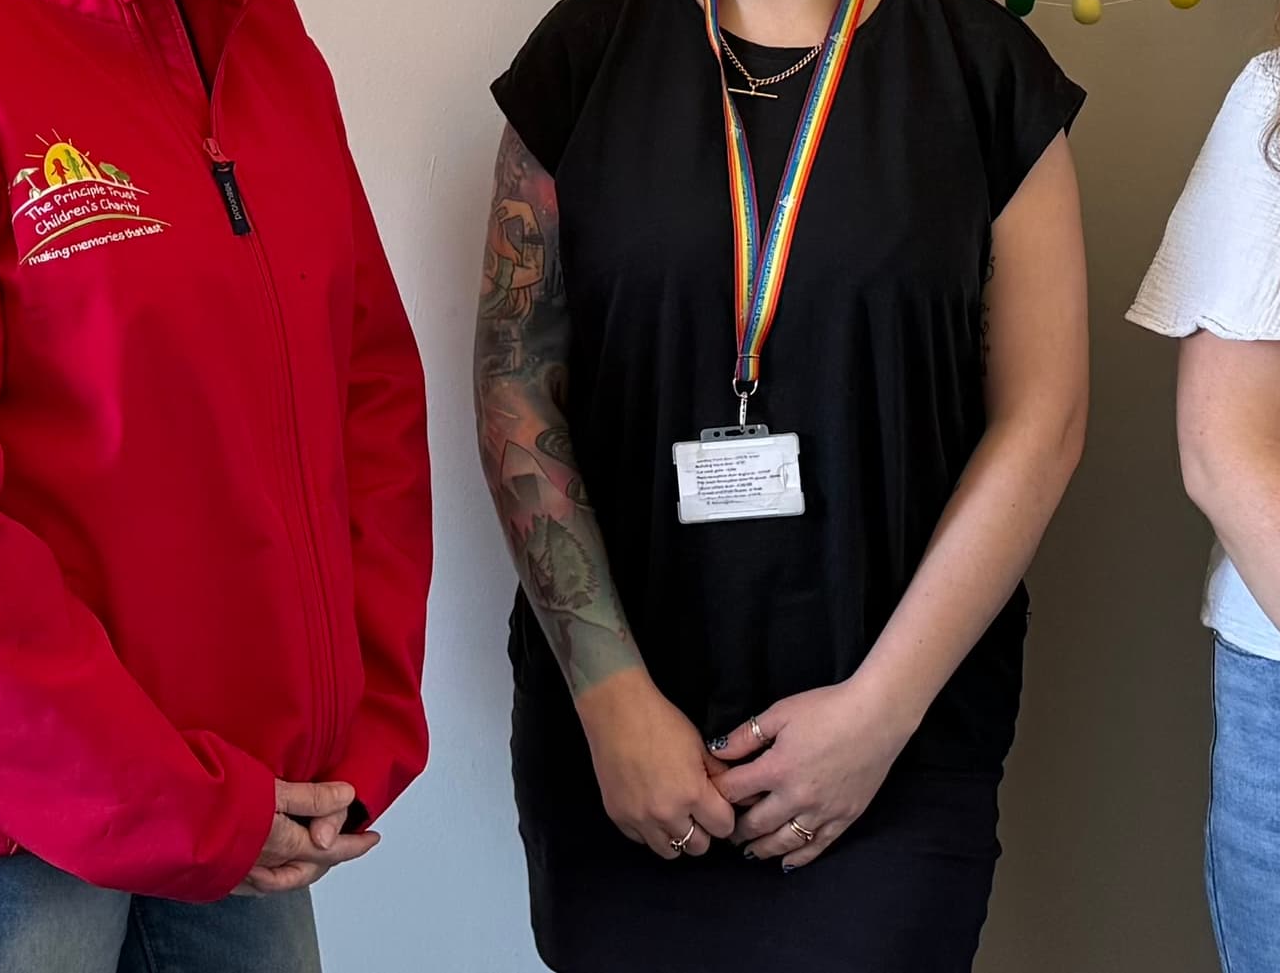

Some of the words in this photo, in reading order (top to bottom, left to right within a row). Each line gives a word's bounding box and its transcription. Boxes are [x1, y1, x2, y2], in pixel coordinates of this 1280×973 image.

[24, 201, 53, 220] The
[54, 183, 106, 206] Principle
[106, 186, 138, 200] Trust
[35, 200, 98, 235] Children's
[100, 198, 140, 216] Charity
[28, 247, 70, 266] making
[70, 231, 125, 253] memories
[124, 227, 146, 239] that
[145, 223, 164, 234] last
